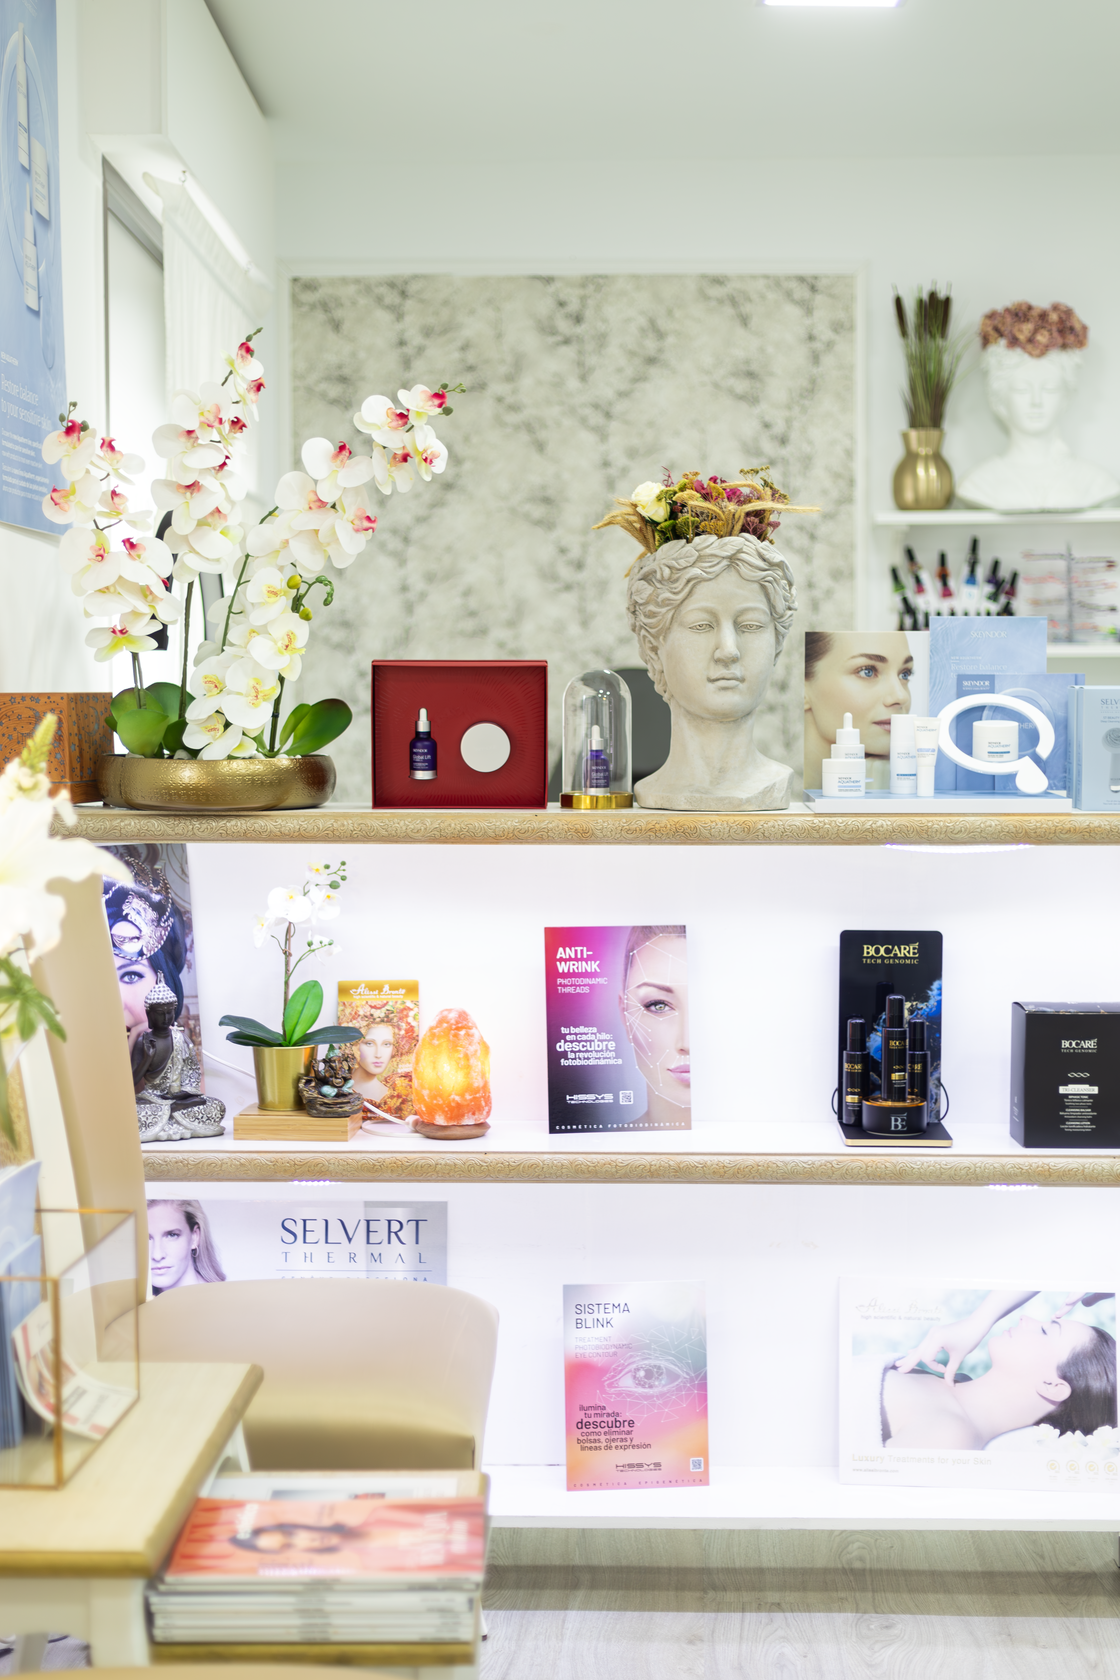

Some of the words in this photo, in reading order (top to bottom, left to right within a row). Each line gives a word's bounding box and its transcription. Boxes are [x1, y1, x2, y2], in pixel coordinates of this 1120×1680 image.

[970, 630, 1007, 639] SKEYNDOR
[951, 663, 978, 671] Restore
[979, 663, 1008, 671] balance
[1100, 698, 1120, 706] SELV
[556, 946, 593, 959] ANTI-
[556, 961, 600, 973] WRINK
[557, 977, 608, 985] PHOTODINAMIC
[557, 986, 590, 994] THREADS
[561, 1026, 569, 1034] tu
[570, 1026, 597, 1034] belleza
[577, 1033, 596, 1041] cada
[596, 1032, 613, 1040] hilo:
[556, 1039, 616, 1052] descubre
[567, 1051, 575, 1059] la
[576, 1050, 616, 1059] revolución
[560, 1057, 622, 1066] fotobiodinámica
[566, 1093, 614, 1101] HISSYS
[280, 1217, 429, 1245] SELVERT
[281, 1251, 428, 1264] THERMAL
[574, 1302, 631, 1315] SISTEMA
[575, 1317, 614, 1329] BLINK
[576, 1418, 635, 1429] descubre
[603, 1429, 633, 1437] eliminar
[604, 1436, 628, 1444] ojeras
[614, 1442, 652, 1451] expresión
[852, 1453, 885, 1465] Luxury
[887, 1454, 934, 1464] Treatments
[937, 1455, 948, 1464] for
[951, 1457, 970, 1466] your
[973, 1457, 992, 1466] Skin
[615, 1461, 662, 1469] HISSYS
